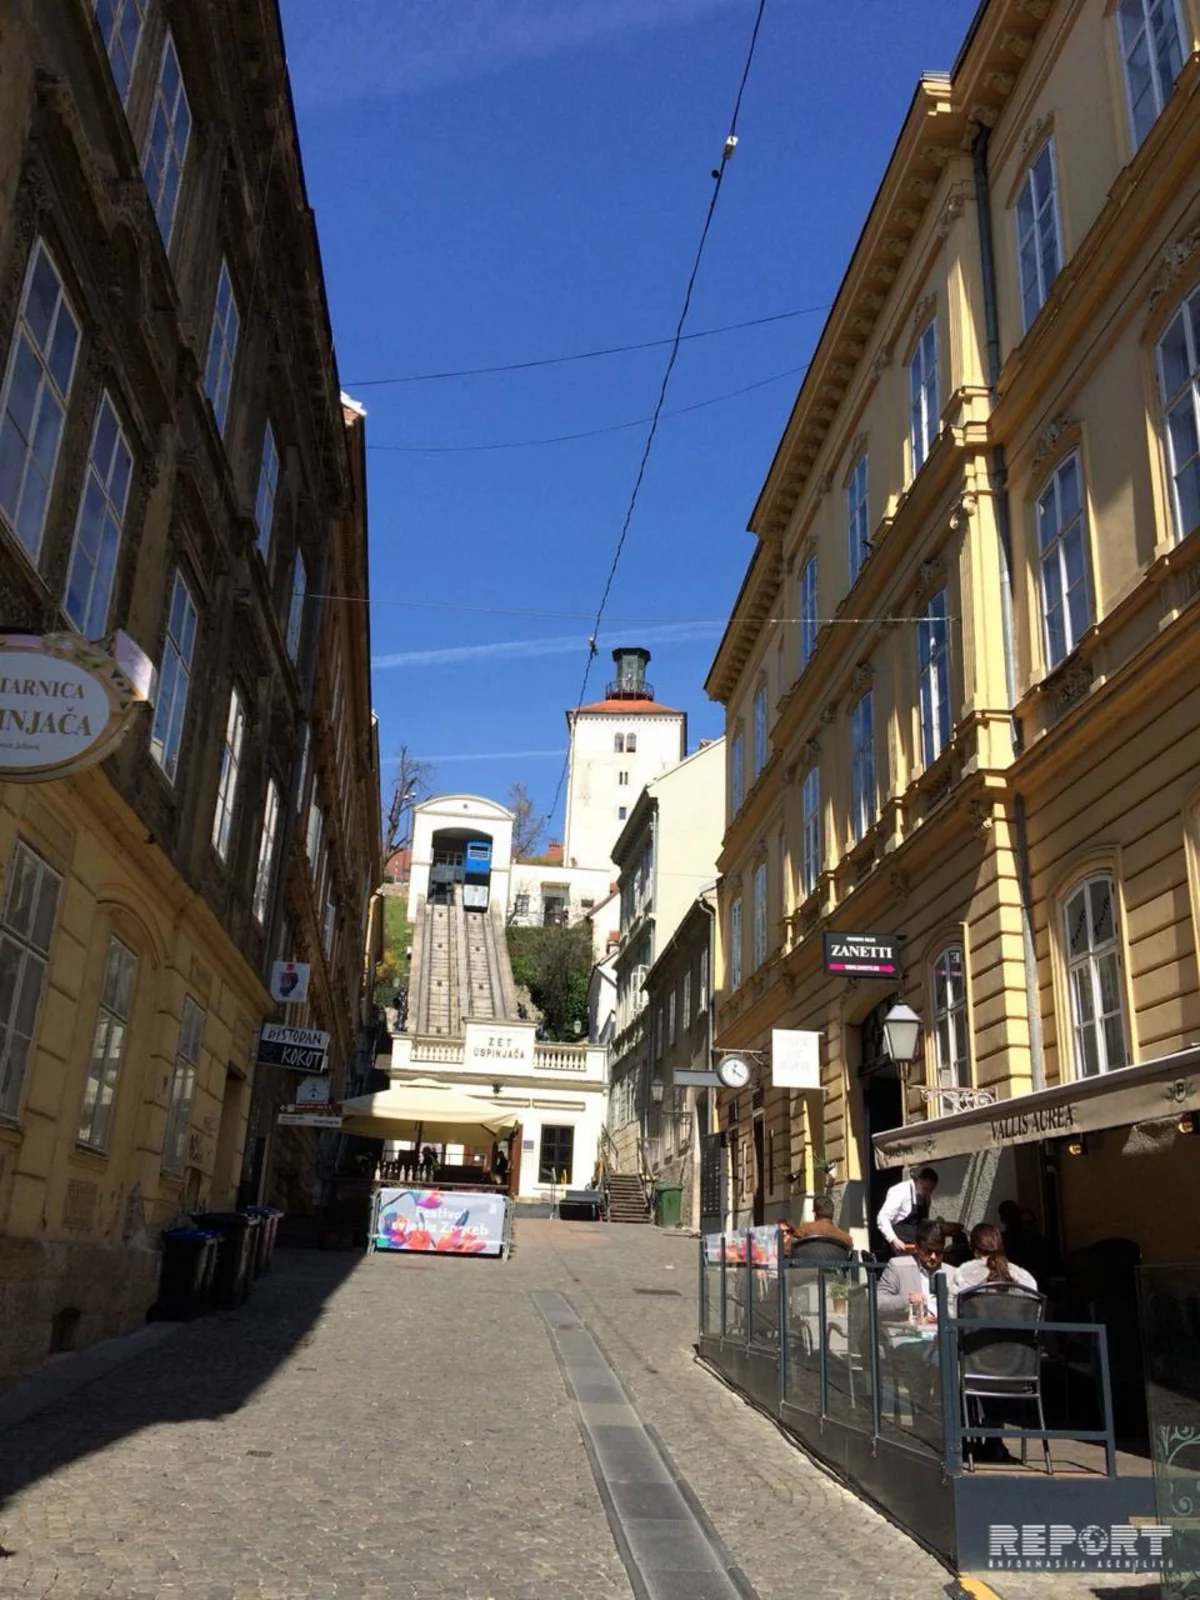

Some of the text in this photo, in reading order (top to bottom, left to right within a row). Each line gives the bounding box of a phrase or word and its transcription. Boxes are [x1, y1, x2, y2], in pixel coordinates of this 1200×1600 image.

[831, 944, 893, 959] ZANETTI
[488, 1037, 513, 1047] ZET
[281, 1046, 323, 1068] KOKOT
[473, 1047, 525, 1059] USPINJAČA
[990, 1104, 1074, 1140] VALLIS AUREA
